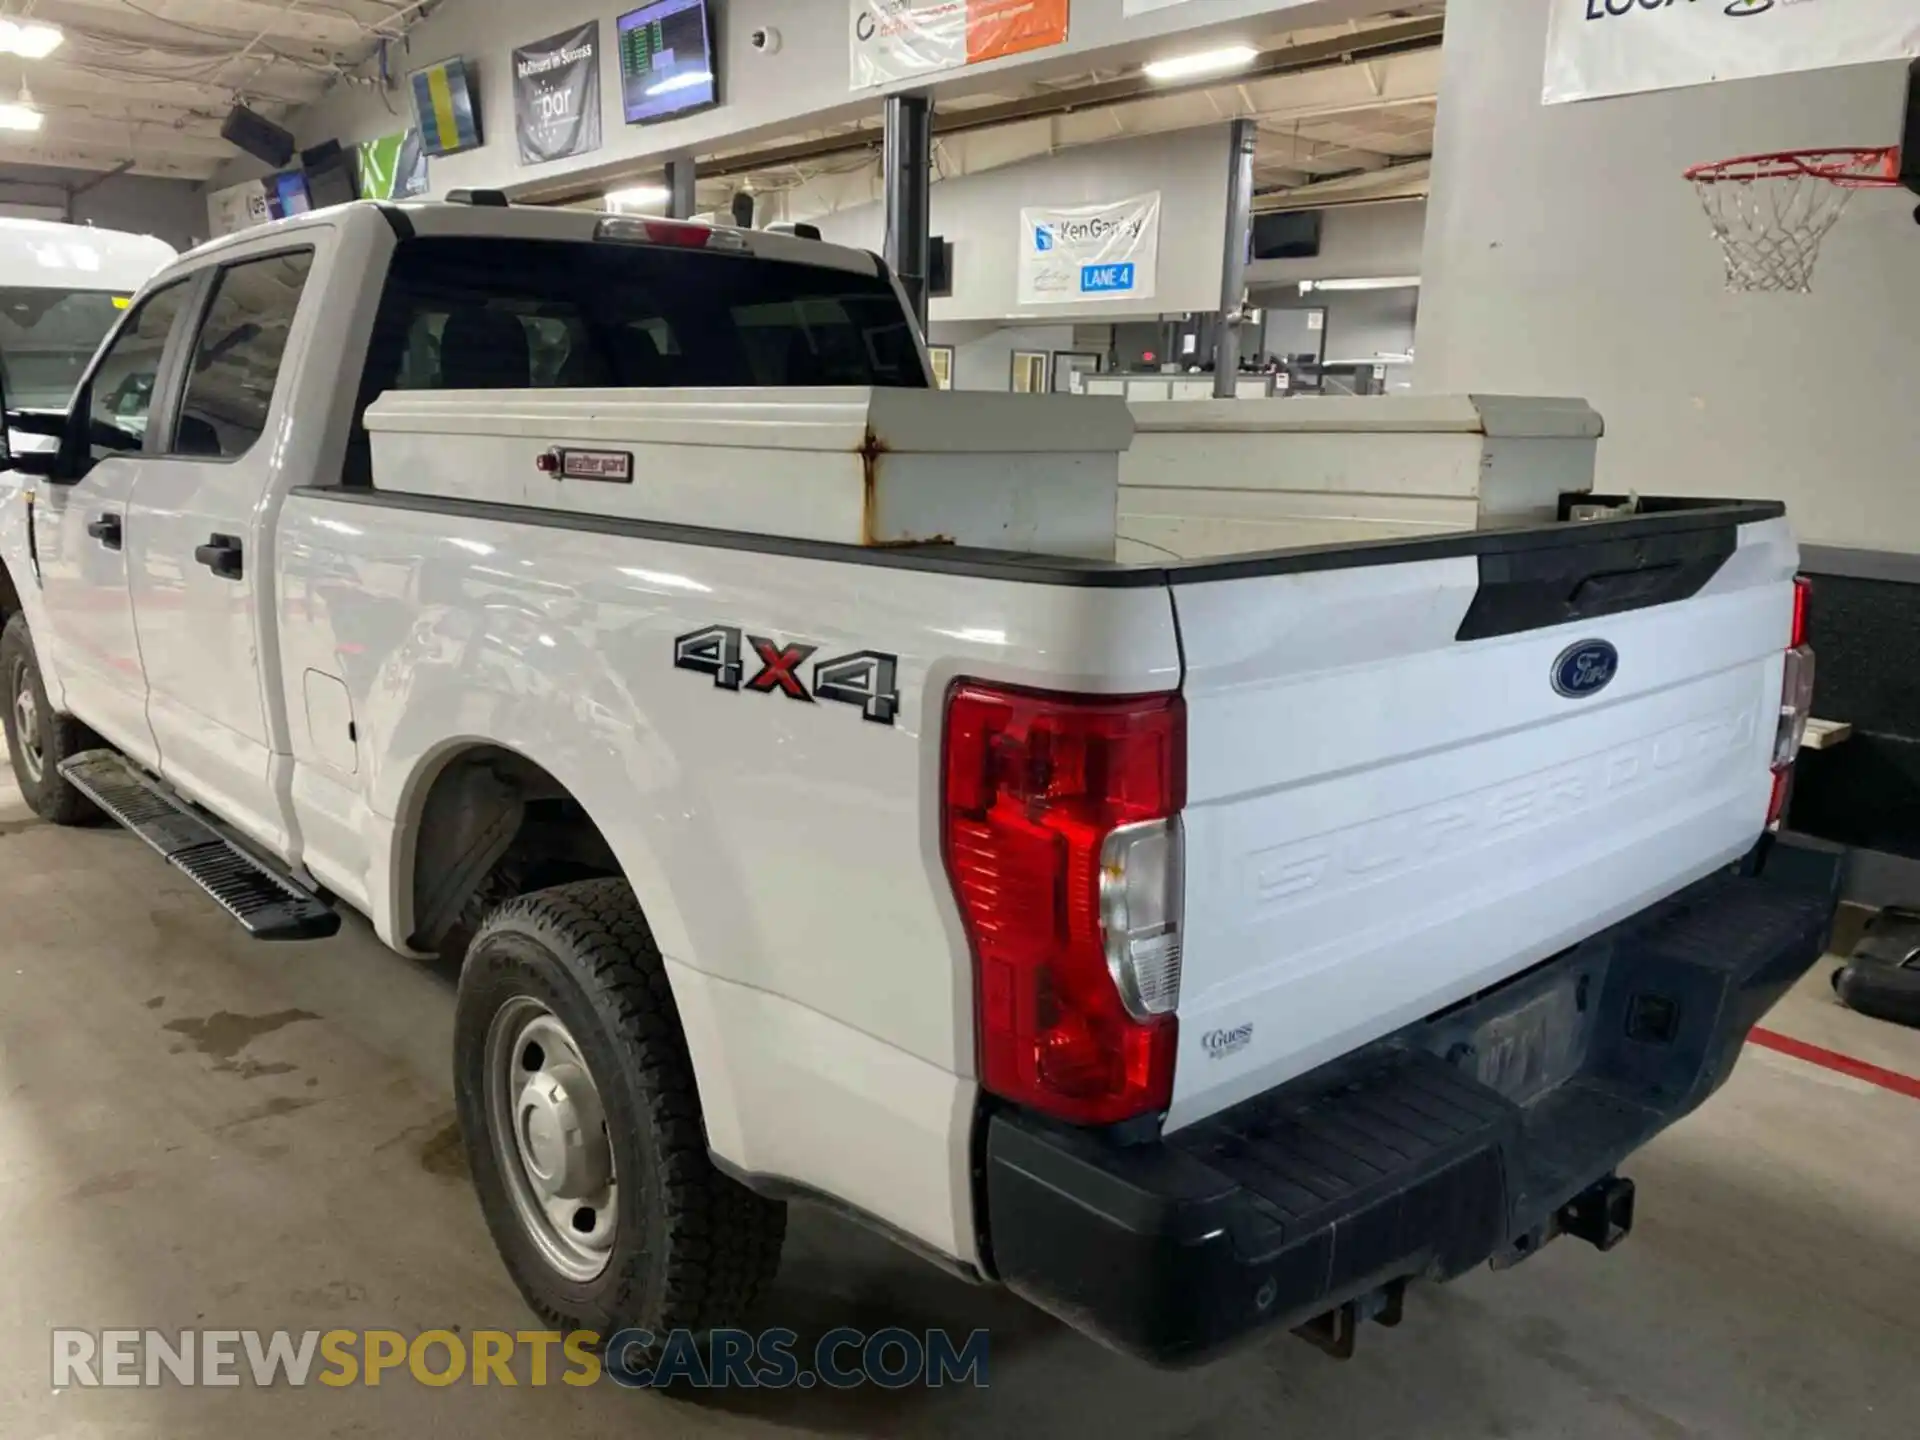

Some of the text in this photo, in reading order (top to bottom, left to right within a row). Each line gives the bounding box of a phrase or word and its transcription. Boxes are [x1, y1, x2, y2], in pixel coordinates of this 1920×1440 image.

[1083, 268, 1117, 287] LANE
[1119, 267, 1129, 285] 4
[1572, 651, 1611, 688] Ford
[1257, 710, 1757, 904] SUPER DUTY
